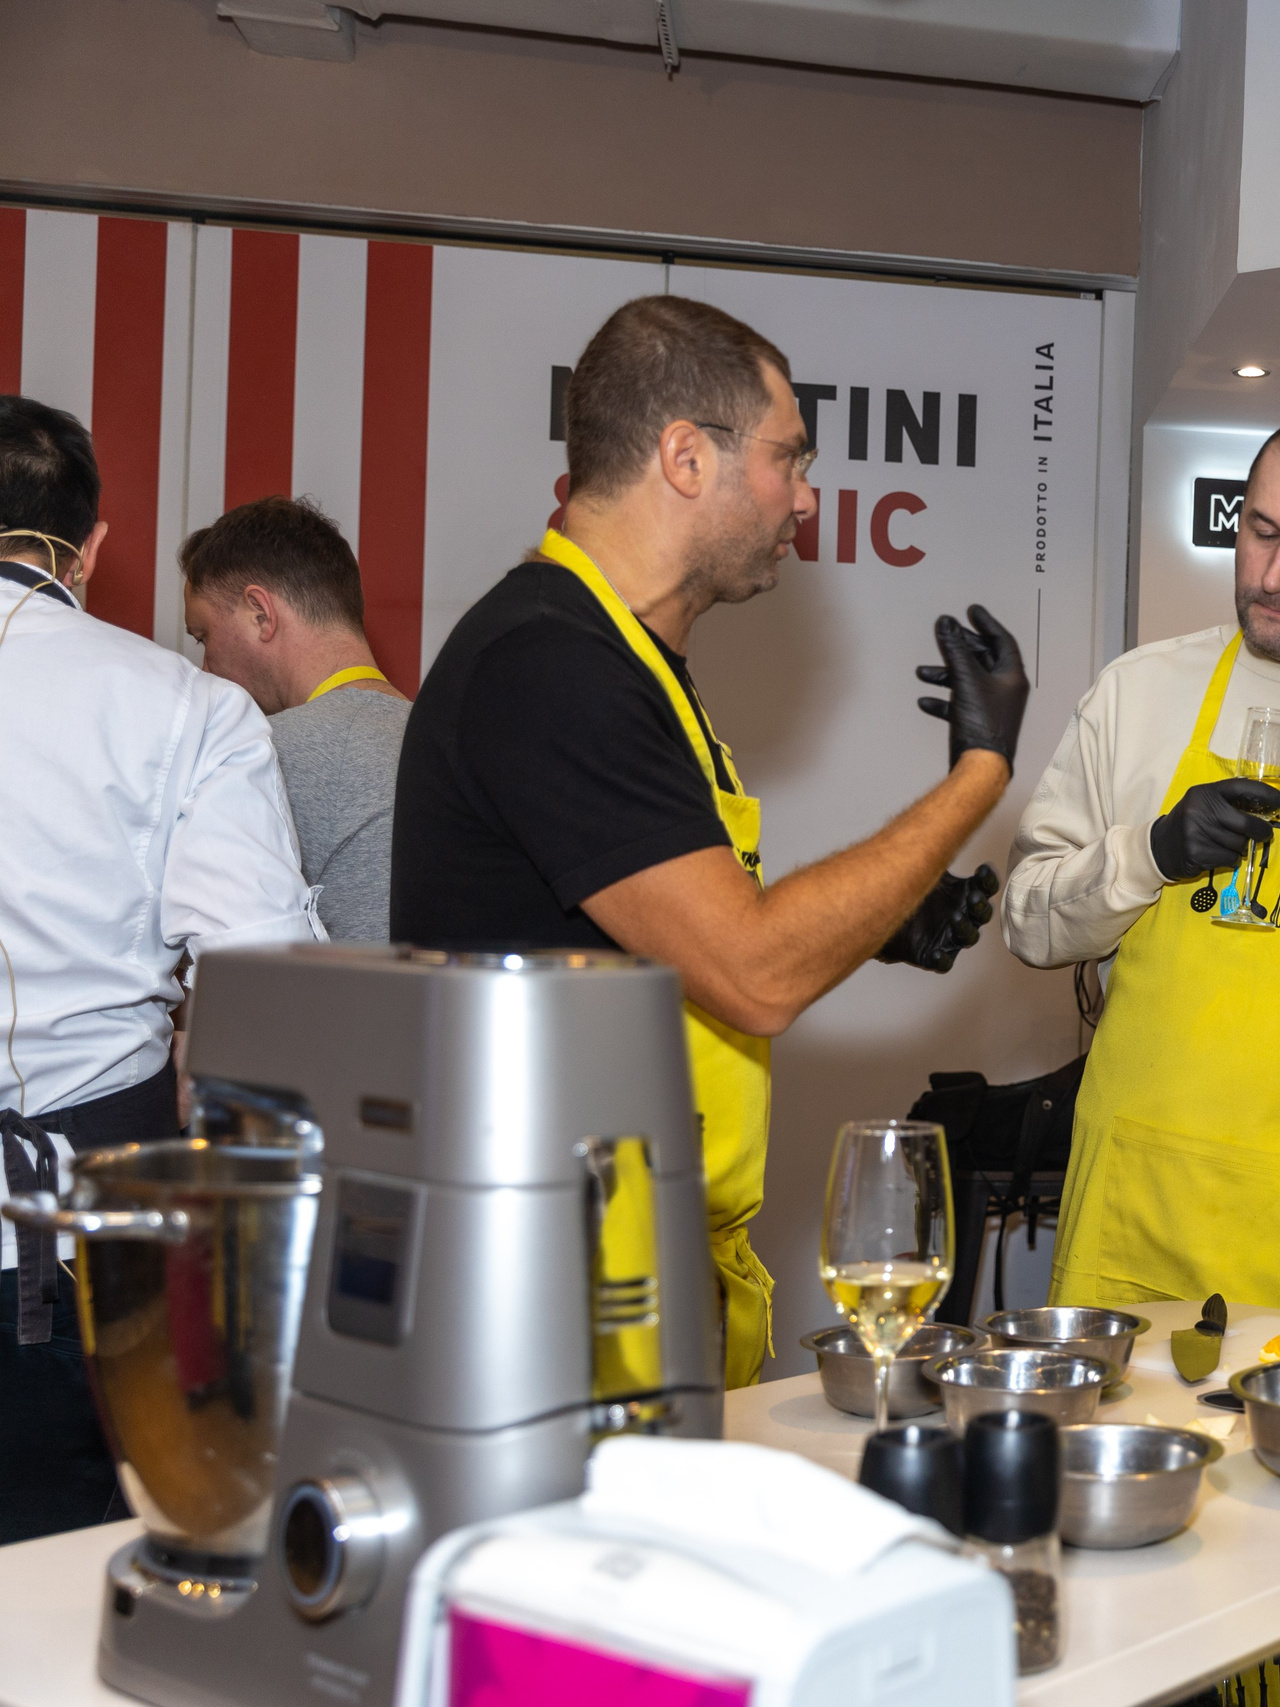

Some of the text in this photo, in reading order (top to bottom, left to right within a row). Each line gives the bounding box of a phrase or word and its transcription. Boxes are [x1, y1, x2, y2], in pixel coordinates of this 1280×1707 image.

[550, 365, 978, 468] TINI
[1033, 342, 1054, 573] PRODOTTO IN ITALIA
